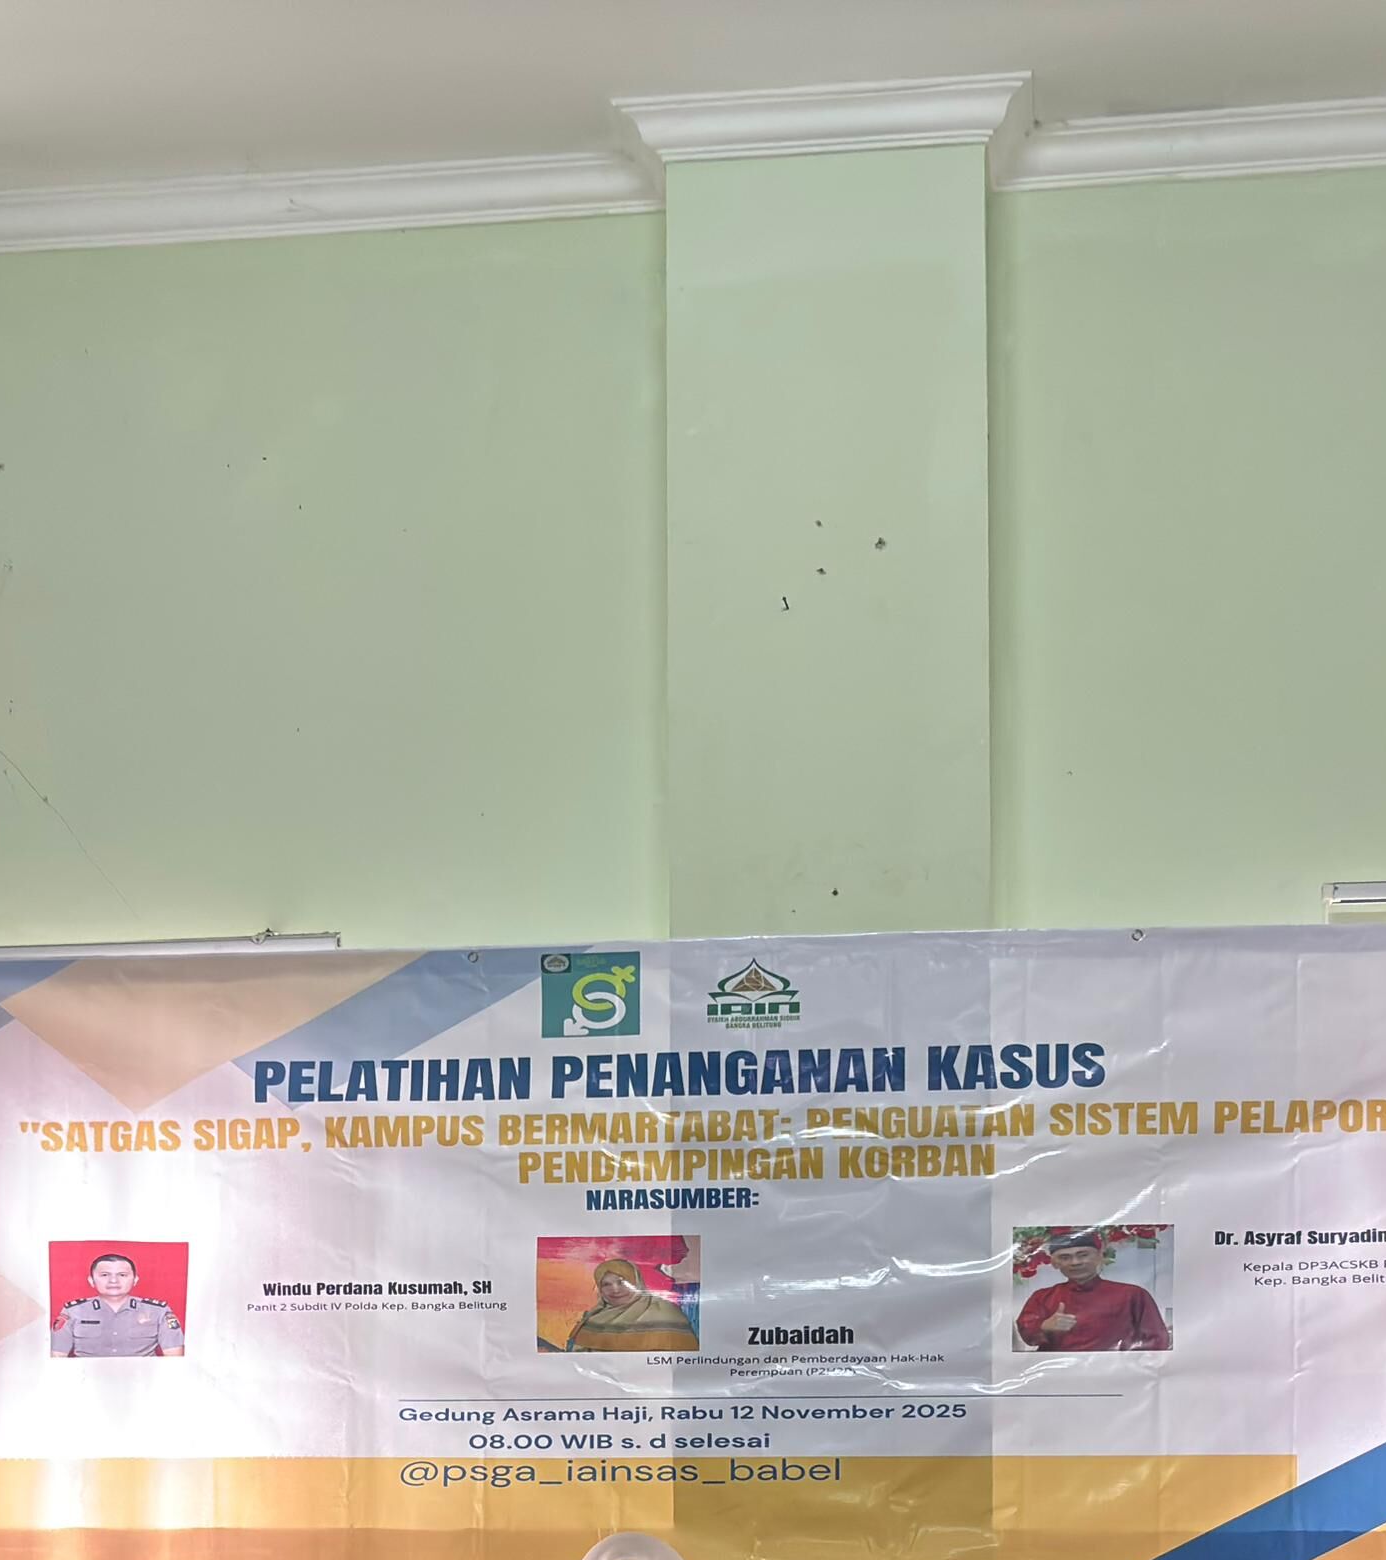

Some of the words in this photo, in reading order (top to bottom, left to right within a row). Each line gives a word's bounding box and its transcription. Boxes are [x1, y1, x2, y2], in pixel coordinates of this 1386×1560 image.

[706, 1001, 801, 1016] IAIN
[254, 1057, 531, 1103] PELATIHAN
[551, 1046, 906, 1099] PENANGANAN
[927, 1042, 1106, 1091] KASUS
[19, 1120, 182, 1153] "SATGAS
[193, 1117, 312, 1153] SIGAP,
[325, 1114, 484, 1149] KAMPUS
[498, 1108, 791, 1146] BERMARTABAT:
[806, 1103, 1035, 1140] PENGUATAN
[1049, 1101, 1198, 1136] SISTEM
[519, 1146, 823, 1184] PENDAMPINGAN
[838, 1143, 996, 1179] KORBAN
[586, 1186, 760, 1211] NARASUMBER:
[1214, 1230, 1239, 1246] Dr.
[1244, 1230, 1302, 1247] Asyraf
[1243, 1262, 1293, 1274] Kepala
[1298, 1259, 1379, 1271] DP3ACSKB
[263, 1282, 312, 1296] Windu
[316, 1281, 383, 1296] Perdana
[388, 1280, 468, 1296] Kusumah,
[472, 1280, 492, 1294] SH
[1254, 1276, 1287, 1287] Kep.
[1291, 1275, 1347, 1287] Bangka
[247, 1303, 278, 1312] Panit
[280, 1303, 287, 1312] 2
[290, 1303, 328, 1312] Subdit
[330, 1303, 341, 1311] IV
[345, 1302, 378, 1311] Polda
[382, 1302, 408, 1313] Kep.
[412, 1302, 455, 1312] Bangka
[459, 1301, 508, 1312] Belitung
[748, 1326, 855, 1345] Zubaidah
[647, 1356, 674, 1366] LSM
[676, 1355, 760, 1367] Perlindungan
[763, 1355, 788, 1365] dan
[791, 1354, 887, 1366] Pemberdayaan
[891, 1353, 945, 1363] Hak-Hak
[730, 1367, 803, 1378] Perempuan
[398, 1407, 495, 1426] Gedung
[503, 1407, 596, 1422] Asrama
[602, 1406, 654, 1424] Haji,
[661, 1405, 724, 1421] Rabu
[730, 1405, 755, 1420] 12
[762, 1404, 895, 1420] November
[901, 1403, 967, 1418] 2025
[469, 1434, 553, 1450] 08.00
[561, 1434, 613, 1449] WIB
[620, 1436, 642, 1449] s.
[649, 1433, 666, 1449] d
[674, 1433, 771, 1449] selesai
[400, 1457, 841, 1488] @psga_iainsas_babel
